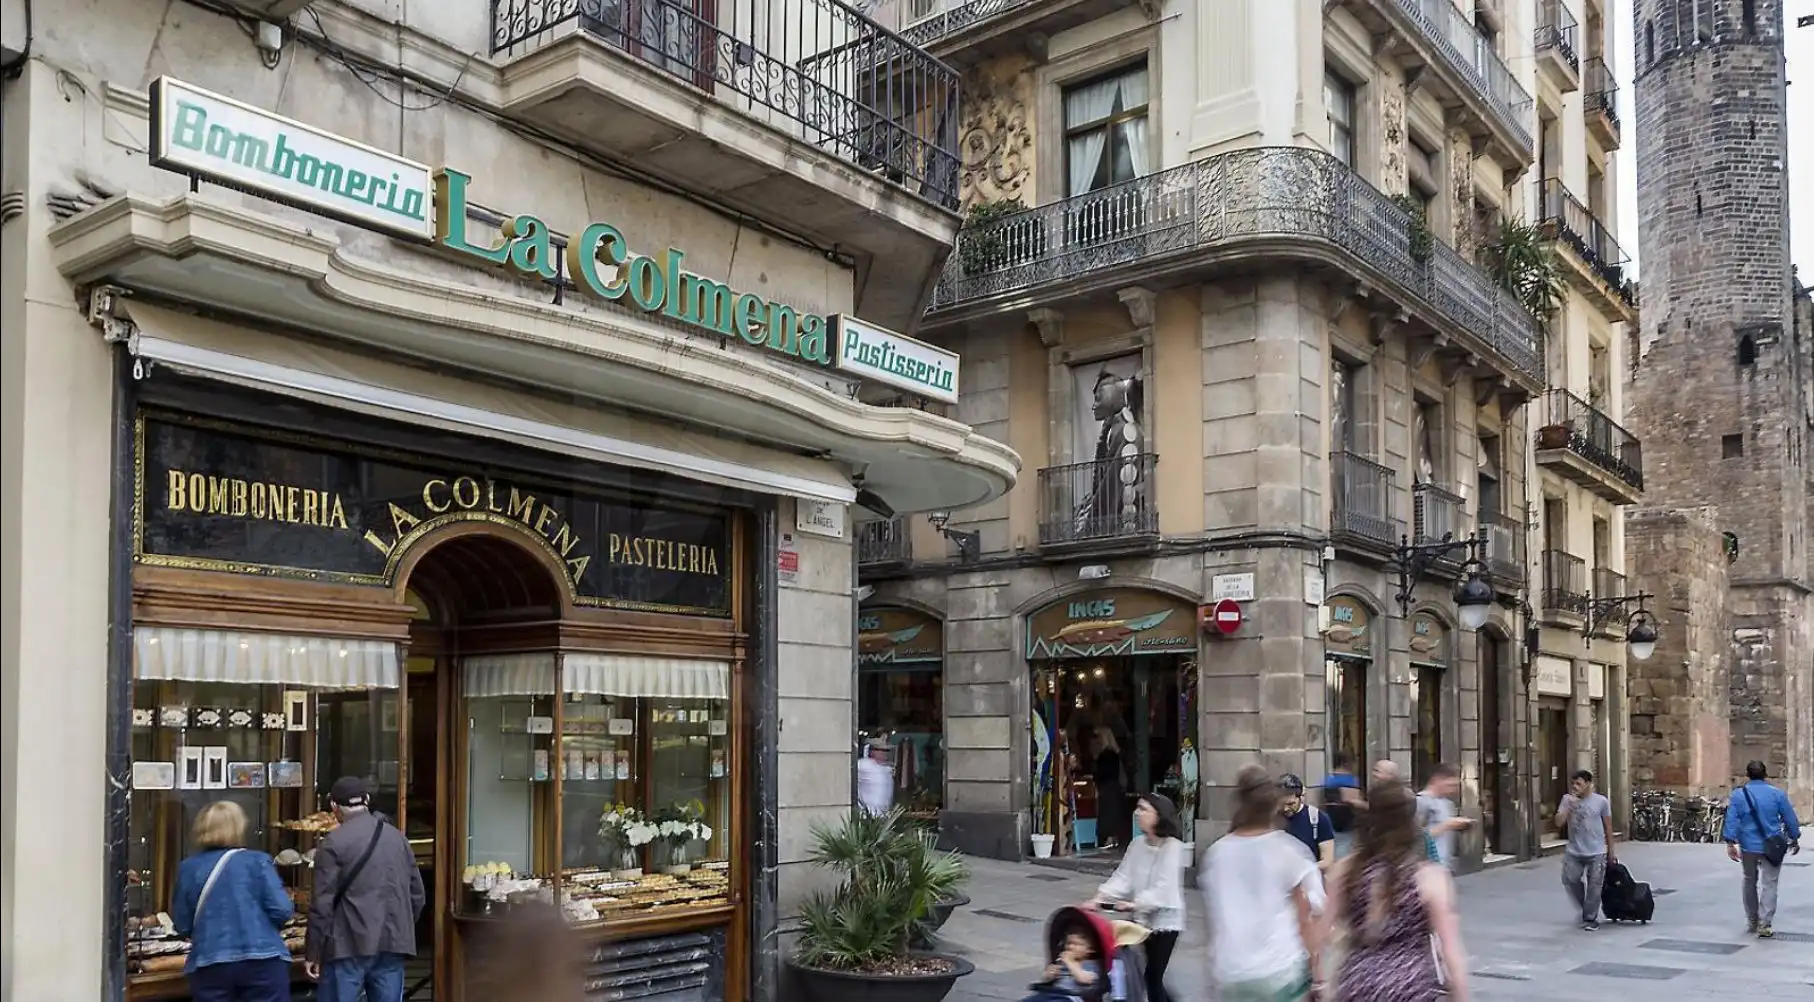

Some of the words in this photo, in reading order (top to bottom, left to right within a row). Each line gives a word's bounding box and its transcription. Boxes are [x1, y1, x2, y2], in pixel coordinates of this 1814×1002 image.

[172, 100, 425, 222] Bomboneria
[434, 167, 557, 279] La
[567, 222, 831, 365] Colmena
[844, 327, 953, 392] Pastisseria
[168, 469, 348, 530] BOMBONERIA
[364, 501, 421, 558] LA
[422, 476, 591, 584] COLMENA
[609, 533, 719, 576] PASTELERIA
[1068, 600, 1116, 618] INCAS
